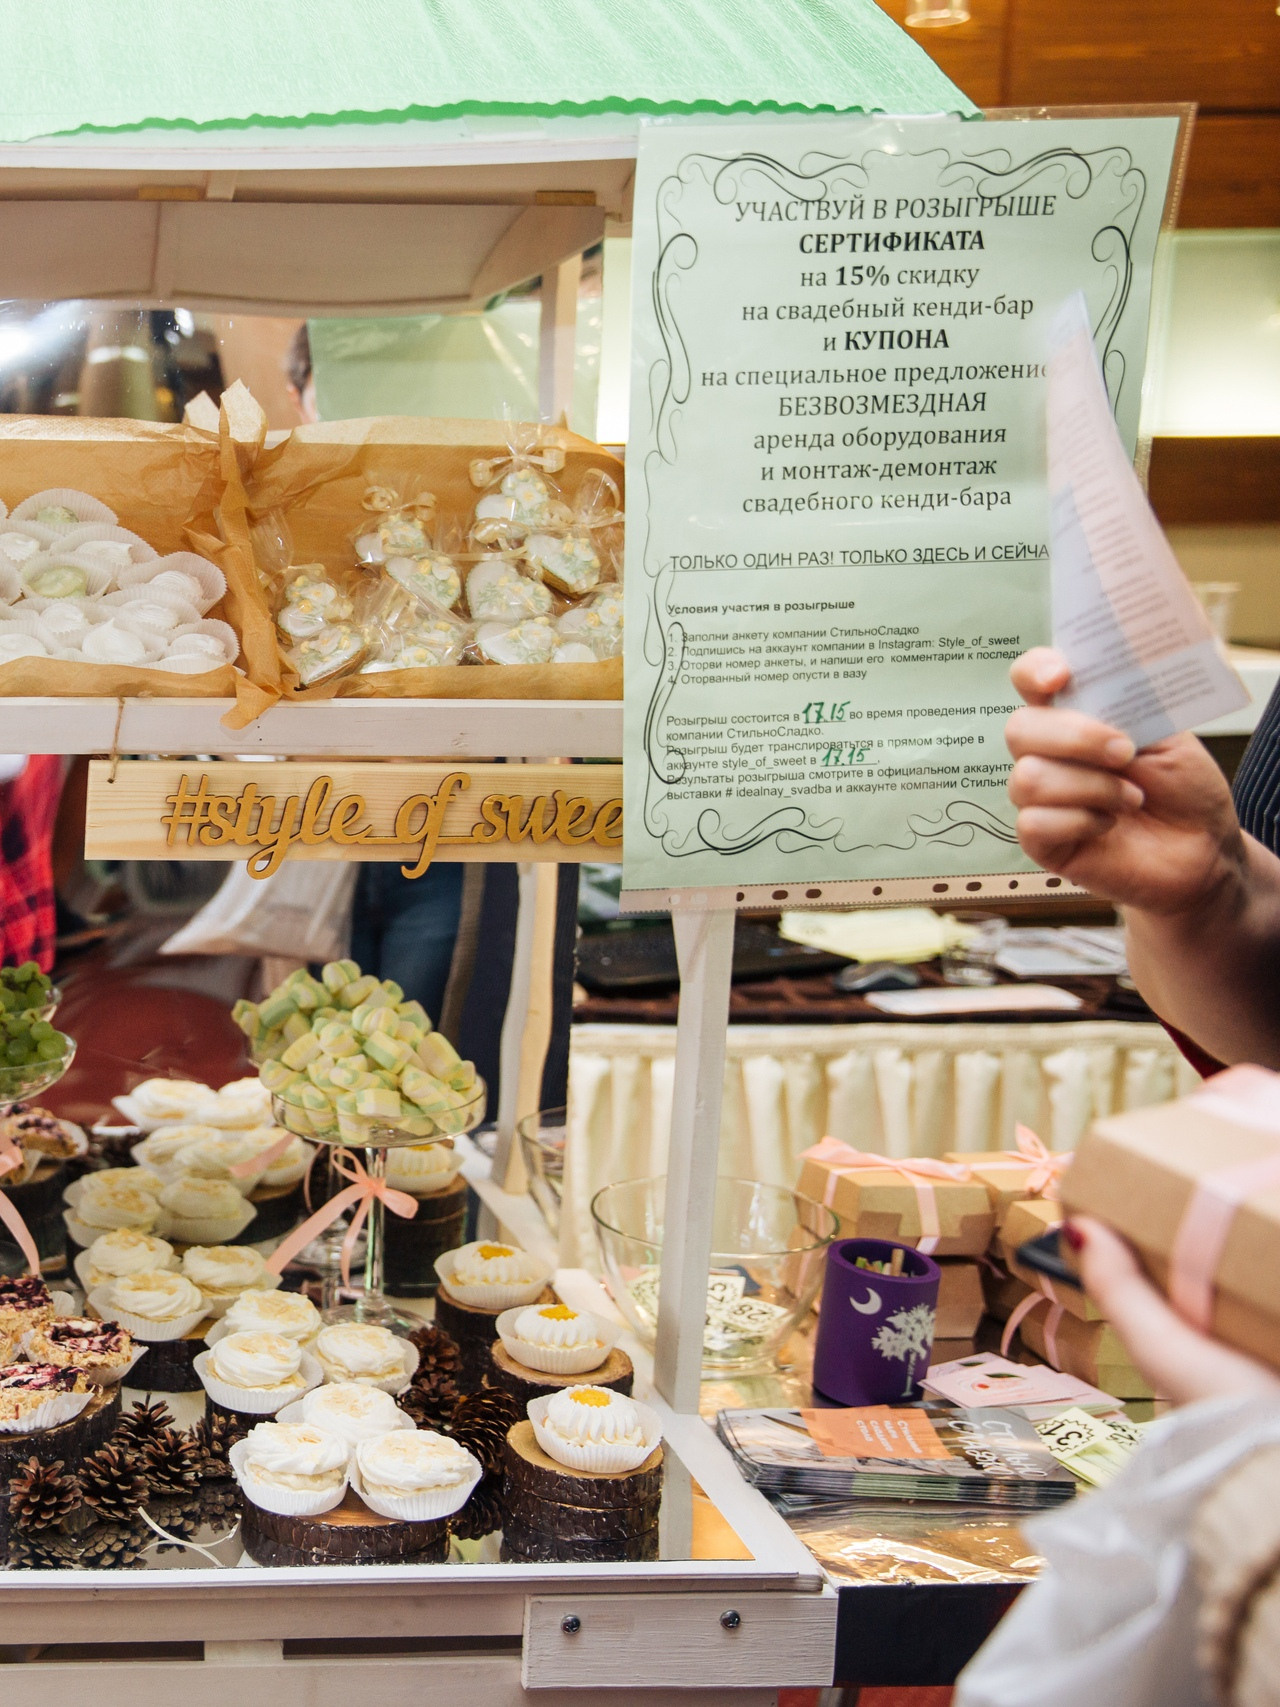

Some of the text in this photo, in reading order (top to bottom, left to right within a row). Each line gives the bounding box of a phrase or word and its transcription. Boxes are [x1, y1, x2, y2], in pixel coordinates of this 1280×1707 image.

[735, 194, 1056, 222] УЧАСТВУЙ В РОЗЫГРЫШЕ
[798, 230, 985, 254] СЕРТИФИКАТА
[800, 265, 980, 288] на 15% скидку
[742, 295, 1034, 323] на свадебный кенди-бар
[823, 329, 950, 351] и КУПОНА
[701, 371, 728, 386] на
[735, 367, 887, 388] специальное
[778, 392, 987, 417] БЕЗВОЗМЕЗДНАЯ
[753, 426, 1006, 454] аренда оборудования
[760, 459, 998, 481] и монтаж-демонтаж
[742, 487, 1012, 514] свадебного кенди-бара
[669, 542, 1049, 570] ТОЛЬКО ОДИН РАЗ! ТОЛЬКО ЗДЕСЬ И СЕЙЧА
[668, 601, 855, 615] Условия участия в розыгрыше
[682, 632, 729, 642] Заполни
[732, 632, 769, 642] анкету
[772, 630, 827, 640] компании
[829, 625, 920, 638] СтильноСладко
[668, 647, 677, 657] 2.
[683, 646, 745, 657] Подпишись
[749, 645, 762, 653] на
[766, 644, 808, 654] аккаунт
[811, 641, 865, 653] компании
[878, 639, 935, 651] Instagram:
[938, 635, 1020, 649] Style_of_sweet
[668, 661, 677, 670] 3.
[681, 660, 721, 671] Оторви
[725, 660, 760, 670] номер
[820, 655, 863, 666] напиши
[867, 655, 884, 664] его
[891, 652, 964, 663] комментарии
[968, 652, 973, 660] к
[977, 650, 1027, 660] последн
[681, 673, 751, 686] Оторванный
[754, 673, 789, 683] номер
[792, 672, 830, 682] опусти
[843, 670, 867, 680] вазу
[667, 715, 727, 728] Розыгрыш
[731, 713, 789, 724] состоится
[794, 713, 799, 721] в
[849, 711, 863, 719] во
[867, 710, 902, 720] время
[907, 707, 976, 719] проведения
[666, 726, 824, 741] компании СтильноСладко.
[666, 744, 728, 757] Розыгрыш
[731, 743, 763, 754] будет
[878, 739, 883, 747] в
[888, 737, 932, 749] прямом
[936, 735, 974, 747] эфире
[978, 735, 984, 743] в
[667, 759, 718, 771] аккаунте
[722, 755, 807, 770] style_of_sweet
[811, 757, 816, 765] в
[666, 763, 1014, 787] Результаты розыгрыша смотрите в официальном аккаунте
[666, 788, 721, 800] выставки
[726, 787, 732, 796] #
[736, 783, 832, 798] idealnay_svadba
[846, 783, 897, 792] аккаунте
[900, 780, 957, 791] компании
[1044, 1422, 1082, 1446] 31
